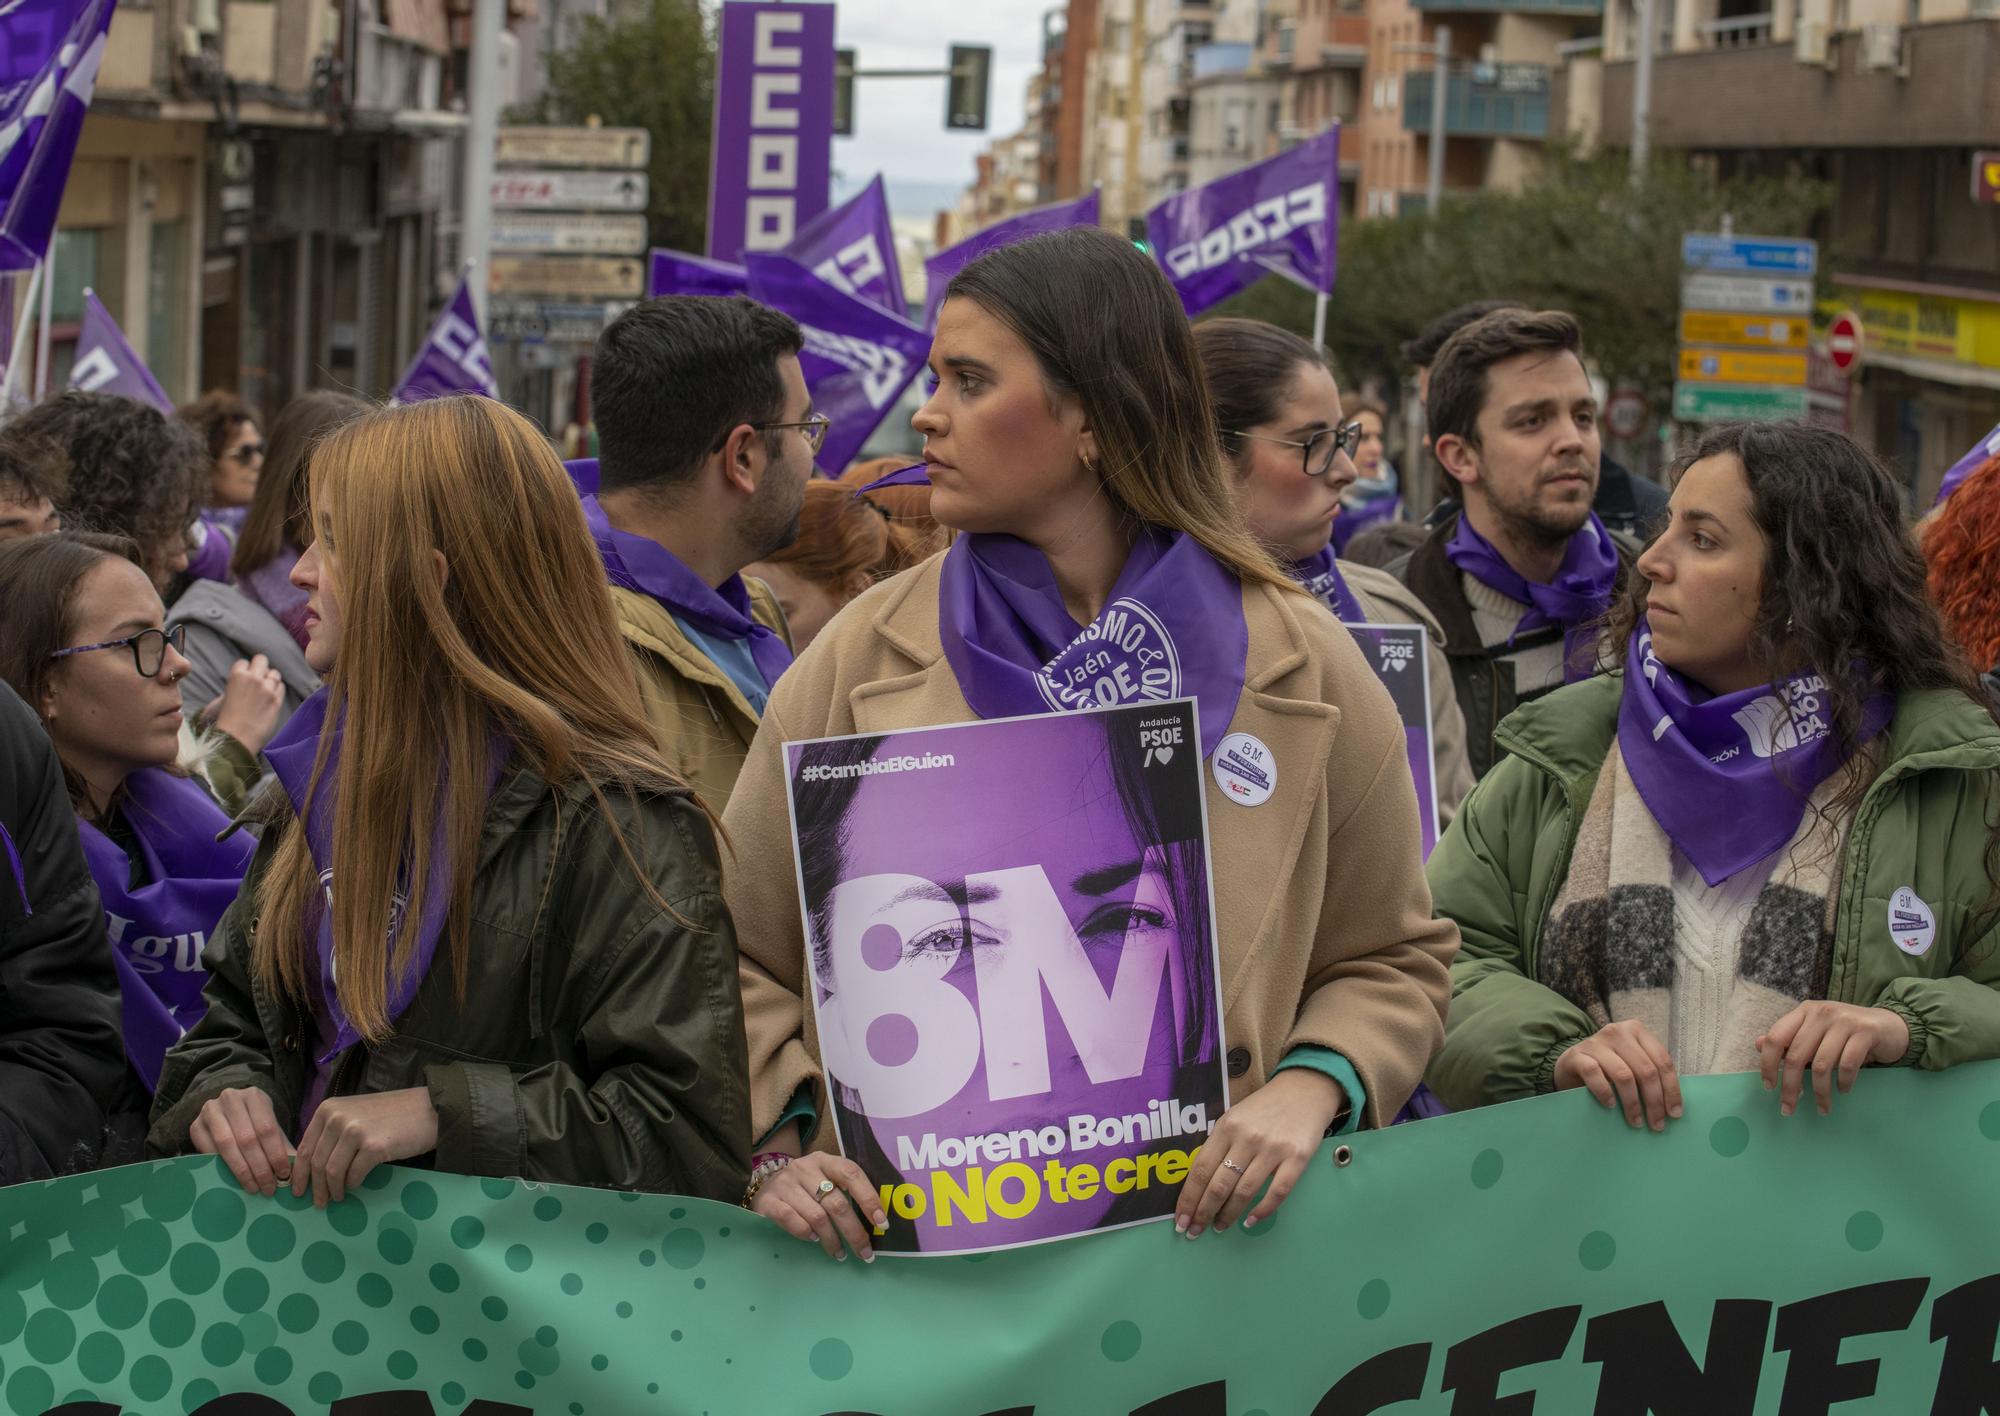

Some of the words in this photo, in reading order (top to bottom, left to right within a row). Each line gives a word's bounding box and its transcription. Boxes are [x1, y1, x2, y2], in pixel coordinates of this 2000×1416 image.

[744, 11, 804, 251] CCOO
[1065, 651, 1112, 688] Jaén
[1380, 645, 1414, 658] PSOE
[1140, 716, 1181, 728] Andalucía
[1789, 695, 1820, 723] NO
[1140, 727, 1183, 748] PSOE
[802, 751, 955, 782] #CambiaElGuion
[105, 910, 208, 974] Igu
[818, 840, 1216, 1120] 8M
[897, 1125, 1066, 1171] Moreno
[931, 1163, 1042, 1227] NO
[1043, 1158, 1101, 1204] te
